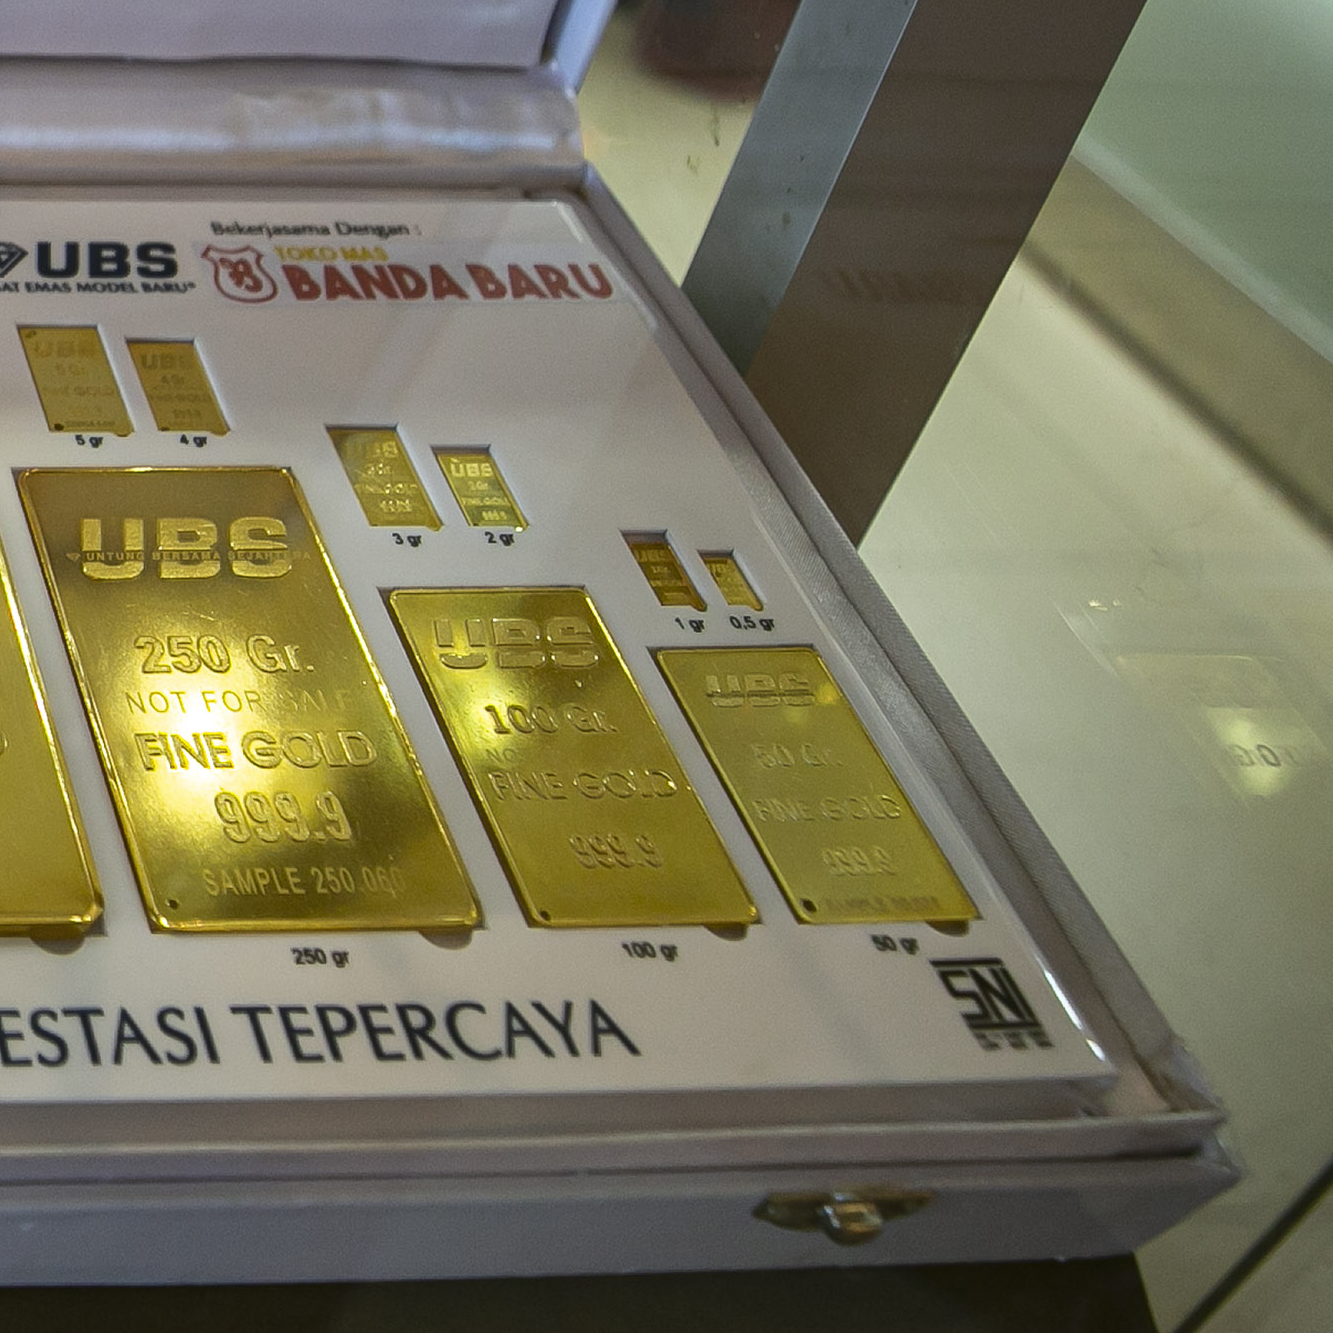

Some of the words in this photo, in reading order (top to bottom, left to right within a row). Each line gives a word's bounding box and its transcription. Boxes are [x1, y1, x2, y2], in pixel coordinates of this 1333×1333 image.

[210, 221, 331, 240] Bekerjasama
[335, 221, 411, 240] Dengan
[37, 240, 179, 279] UBS
[274, 246, 337, 262] TOKO
[339, 246, 389, 262] MAS
[25, 281, 72, 293] EMAS
[76, 282, 139, 294] MODEL
[281, 263, 469, 301] BANDA
[465, 262, 614, 301] BARU
[75, 434, 85, 446] 5
[88, 436, 104, 449] gr
[179, 434, 189, 445] 4
[193, 435, 208, 448] gr
[79, 515, 294, 582] UBS
[392, 532, 404, 546] 3
[407, 534, 423, 548] gr
[484, 531, 497, 544] 2
[499, 533, 515, 547] gr
[85, 551, 144, 562] UNTUNG
[151, 551, 221, 562] BERSAMA
[674, 616, 685, 630] 1
[688, 617, 706, 633] gr
[729, 615, 757, 631] 0,5
[758, 617, 776, 632] gr
[134, 633, 233, 675] 250
[244, 633, 316, 674] Gr.
[433, 617, 600, 670] UBS
[124, 689, 187, 715] NOT
[203, 689, 262, 714] FOR
[704, 671, 817, 709] UBS
[484, 704, 562, 736] 100
[133, 731, 235, 771] FINE
[240, 729, 379, 771] GOLD
[486, 769, 569, 802] FINE
[572, 768, 679, 801] GOLD
[213, 789, 354, 846] 999.9
[753, 797, 817, 824] FINE
[819, 794, 903, 821] GOLD
[568, 832, 665, 870] 999.9
[202, 867, 307, 897] SAMPLE
[291, 947, 328, 966] 250
[331, 949, 351, 968] gr
[620, 941, 657, 960] 100
[660, 944, 679, 962] gr
[869, 933, 899, 952] 50
[901, 936, 921, 956] gr
[229, 998, 642, 1064] TEPERCAYA
